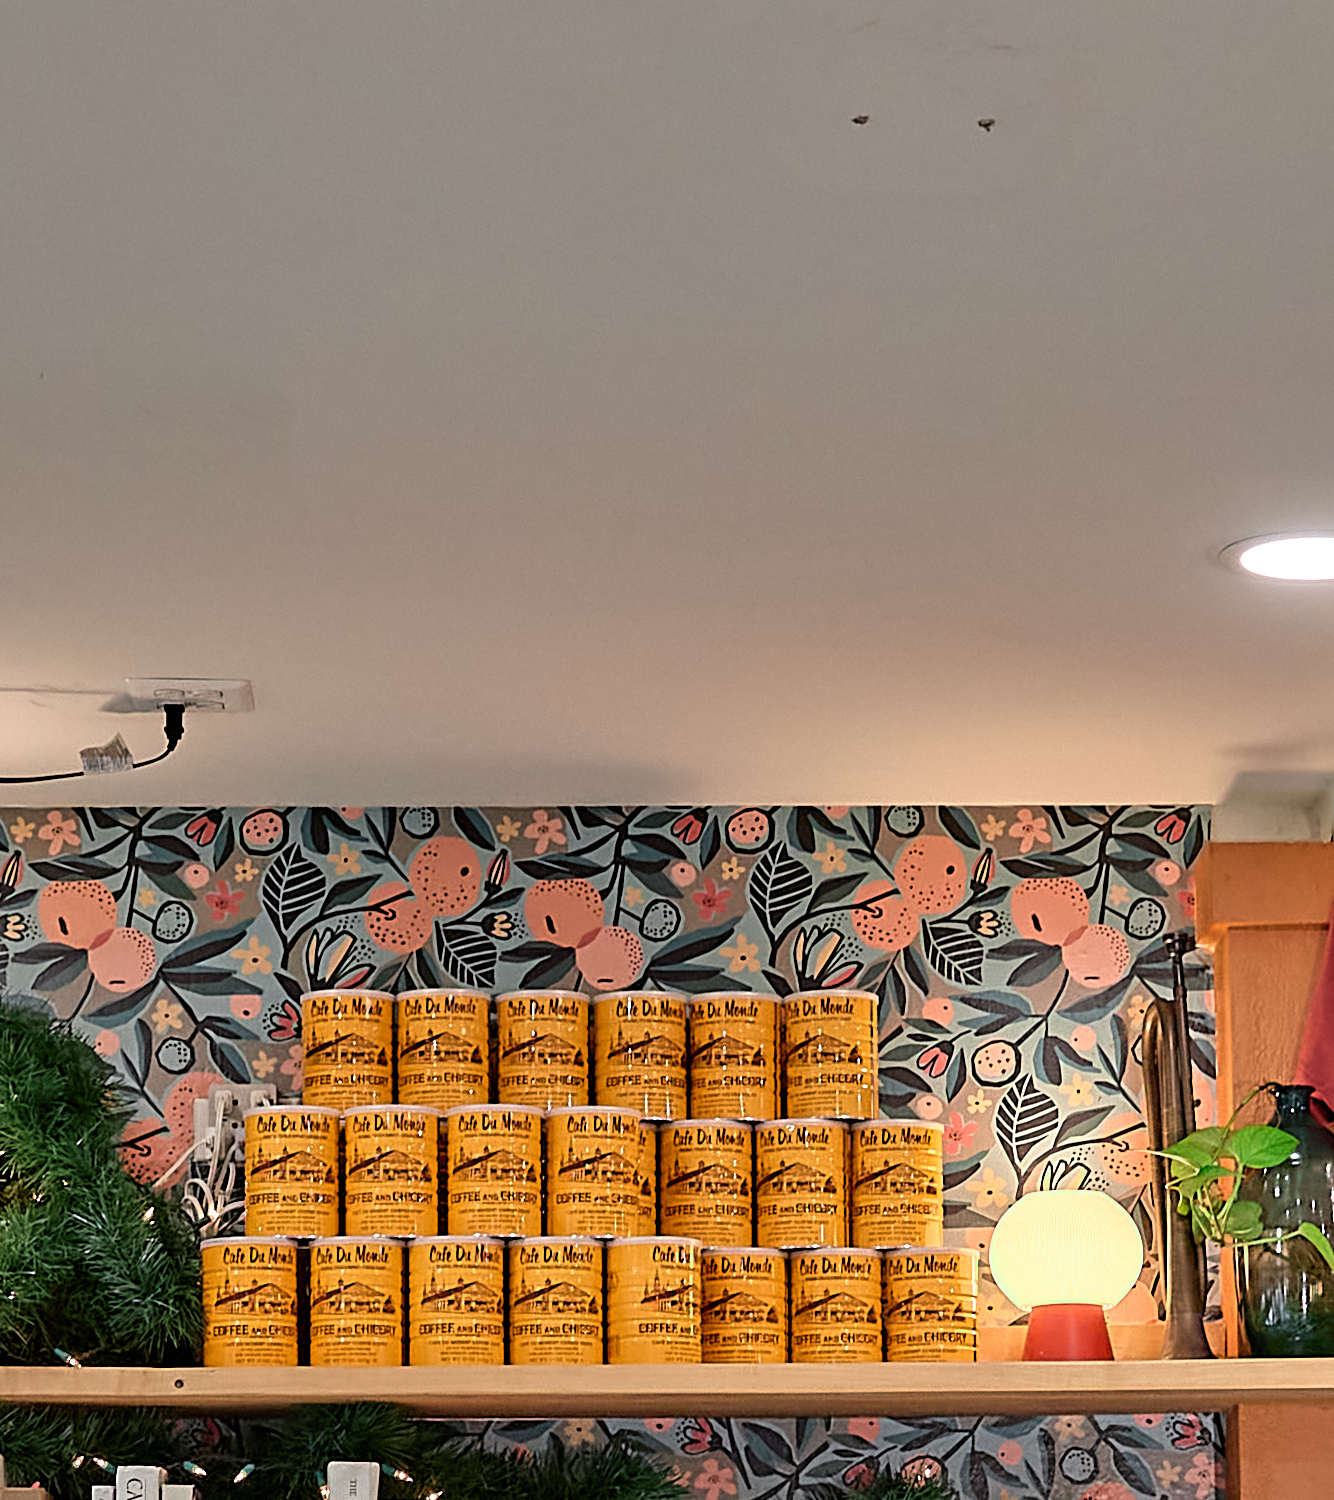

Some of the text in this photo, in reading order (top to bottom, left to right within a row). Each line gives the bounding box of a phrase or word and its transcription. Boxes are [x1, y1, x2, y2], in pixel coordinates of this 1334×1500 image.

[426, 999, 442, 1013] Du
[281, 1116, 297, 1131] Du
[349, 1479, 357, 1496] THE
